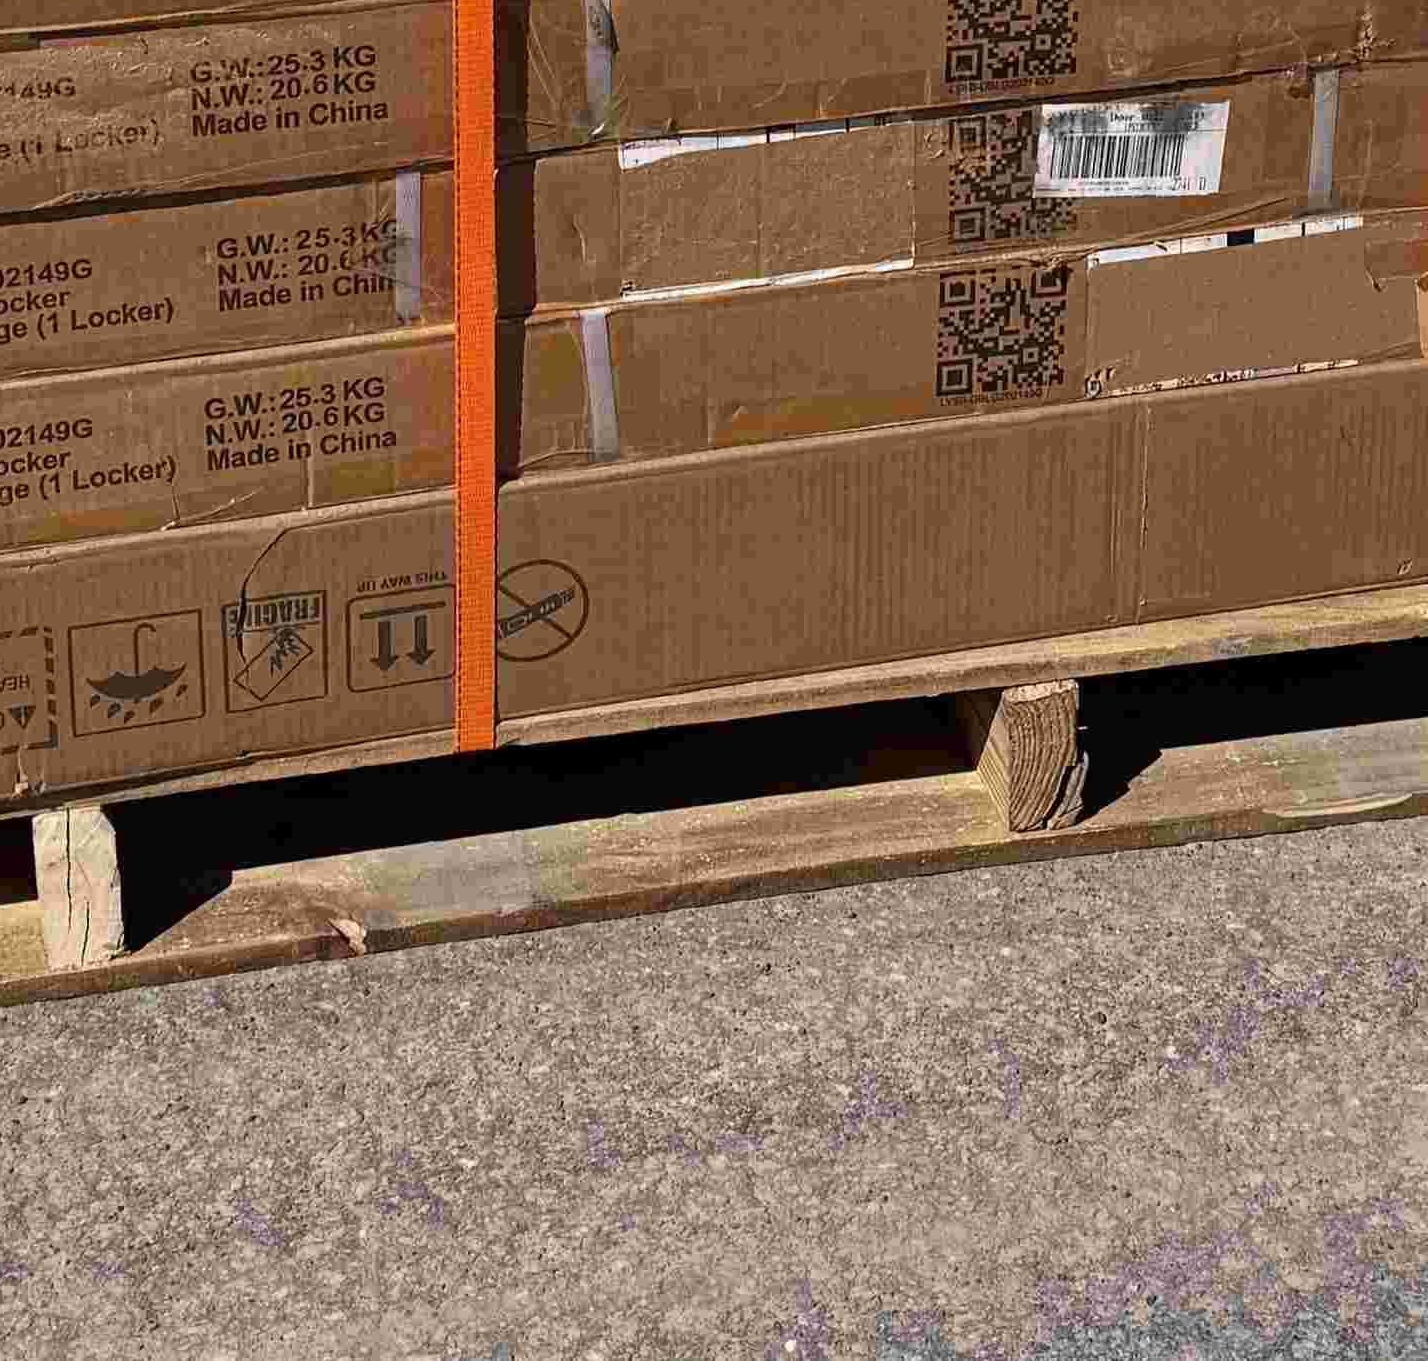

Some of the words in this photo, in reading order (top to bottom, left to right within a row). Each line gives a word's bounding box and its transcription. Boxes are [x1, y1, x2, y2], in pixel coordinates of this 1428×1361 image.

[267, 49, 326, 75] 25.3
[333, 45, 376, 69] KG
[192, 83, 263, 111] N.W.:
[270, 73, 329, 101] 20.6
[333, 71, 376, 94] KG
[192, 110, 268, 137] Made
[276, 107, 301, 129] in
[308, 100, 389, 126] China
[217, 234, 289, 259] G.W.:
[296, 226, 356, 252] 25.3
[218, 259, 289, 286] N.W.:
[219, 284, 292, 312] Made
[299, 280, 325, 303] in
[37, 312, 59, 341] (1
[71, 297, 176, 331] Locker)
[204, 392, 275, 419] G.W.:
[280, 383, 337, 410] 25.3
[343, 376, 386, 401] KG
[205, 419, 275, 446] N.W.:
[282, 406, 339, 433] 20.6
[343, 402, 386, 427] KG
[208, 443, 280, 470] Made
[288, 438, 312, 460] in
[320, 430, 397, 455] China
[39, 473, 61, 501] (1
[72, 455, 177, 492] Locker)
[380, 575, 412, 589] WAY
